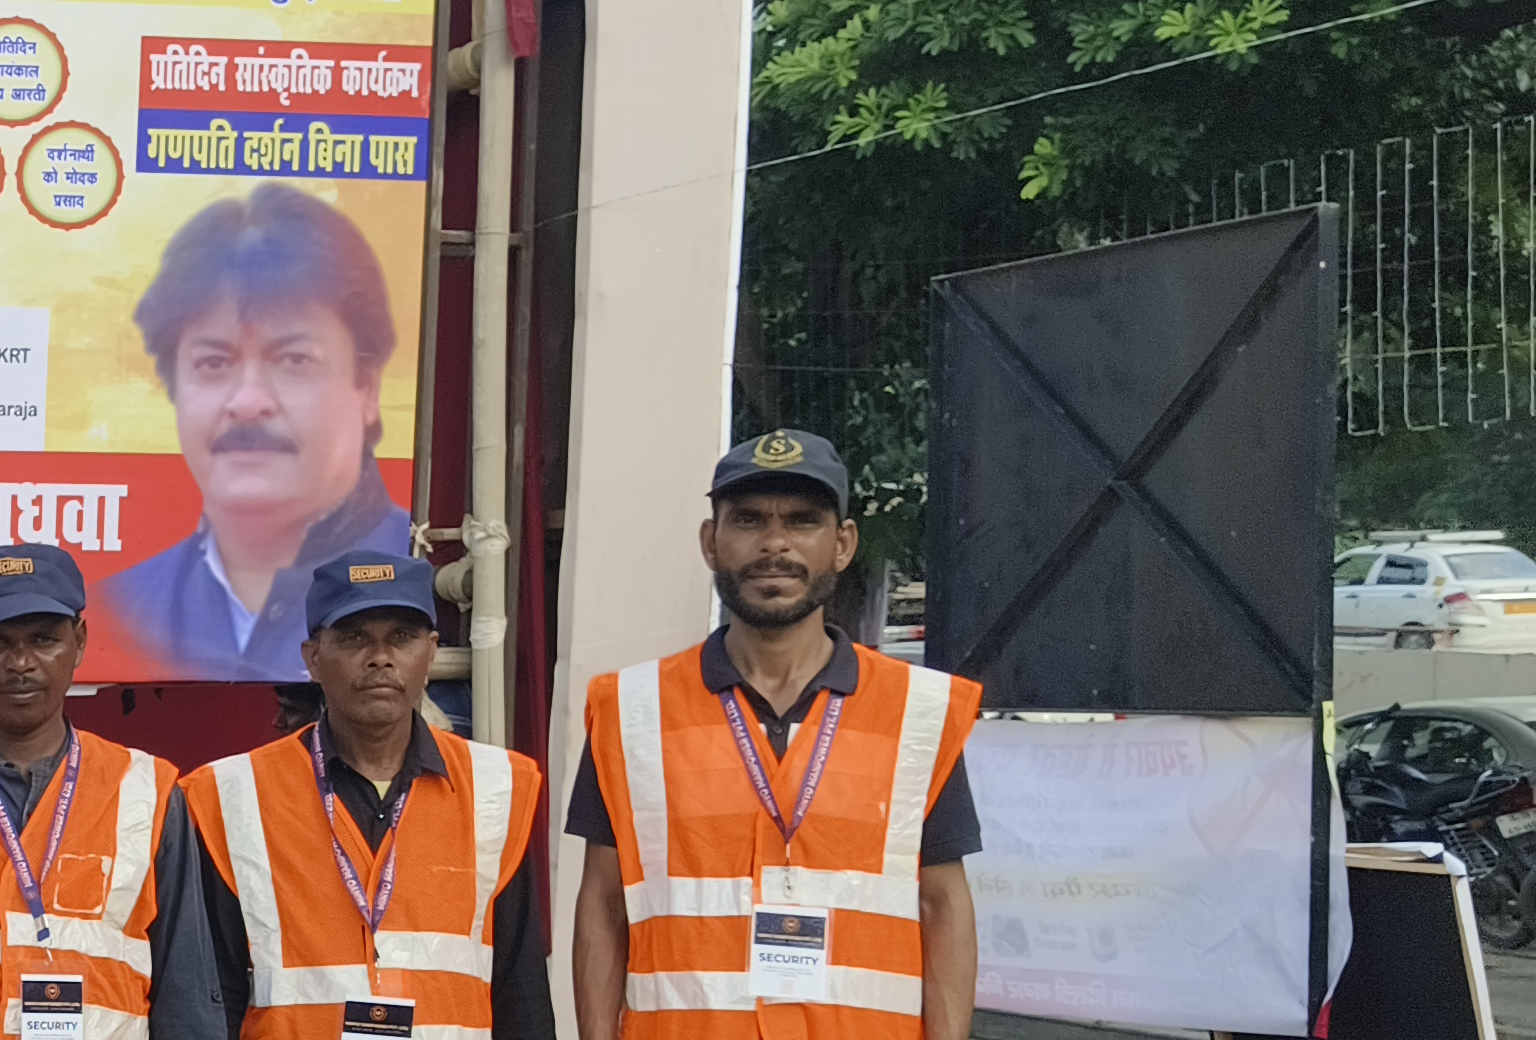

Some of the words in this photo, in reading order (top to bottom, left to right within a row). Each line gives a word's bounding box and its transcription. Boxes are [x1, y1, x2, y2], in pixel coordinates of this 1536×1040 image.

[149, 44, 228, 92] प्रतिदिन
[234, 46, 335, 106] सांस्कृतिक
[340, 50, 422, 97] कार्यक्रम
[11, 83, 46, 101] आरती
[46, 143, 95, 162] दर्शनार्थी
[147, 119, 238, 169] गणपति
[243, 118, 303, 171] दर्शन
[309, 121, 364, 173] बिना
[369, 136, 418, 175] पास
[42, 167, 58, 184] को
[64, 168, 98, 185] मोदक
[53, 195, 85, 208] प्रसाद
[758, 952, 820, 967] SECURITY
[26, 1020, 79, 1032] SECURITY
